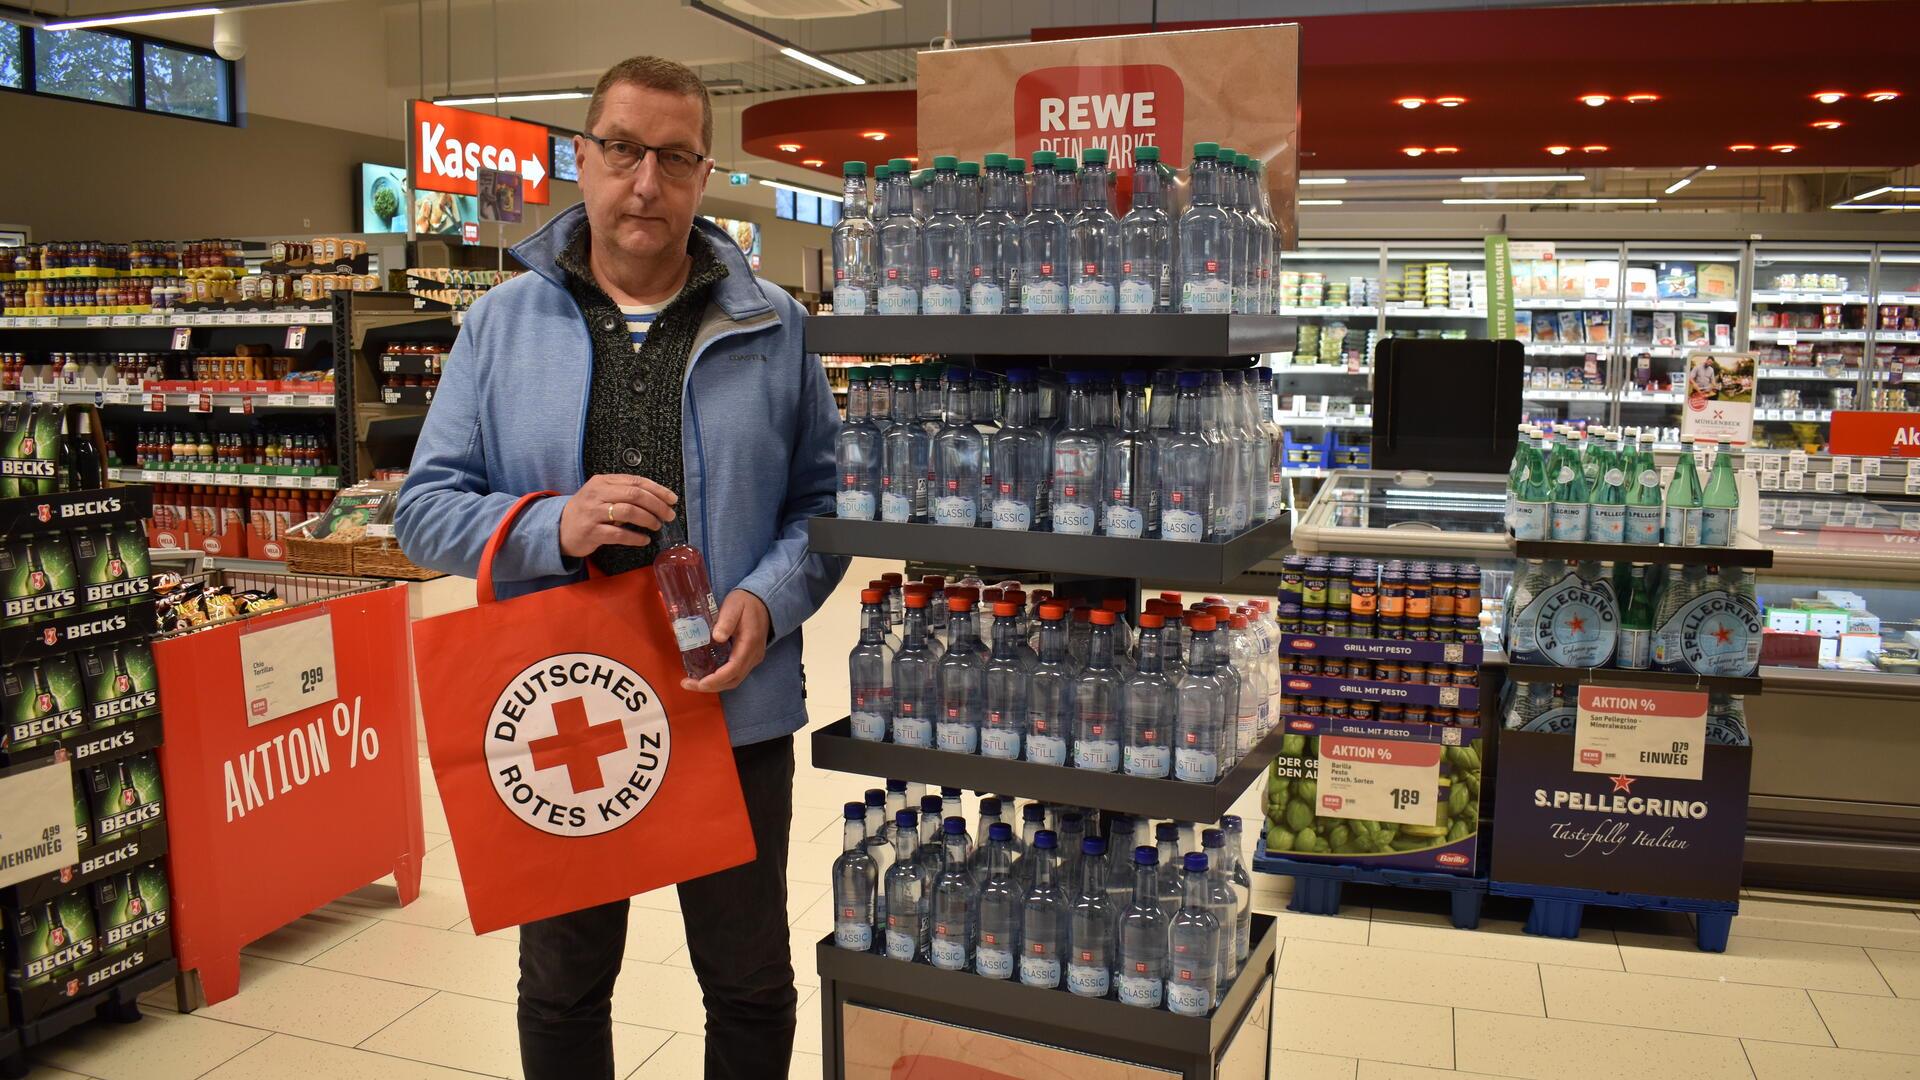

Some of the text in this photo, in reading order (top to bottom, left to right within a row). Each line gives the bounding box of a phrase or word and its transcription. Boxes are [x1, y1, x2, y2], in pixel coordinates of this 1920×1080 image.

[1040, 92, 1157, 132] REWE
[421, 121, 517, 182] Kasse
[1495, 242, 1505, 300] MARGARINE
[1029, 294, 1064, 304] MEDIUM
[1074, 294, 1109, 304] MEDIUM
[1192, 293, 1229, 303] MEDIUM
[1695, 418, 1740, 427] MÜHLENBECK
[2, 460, 55, 476] BECK'S
[61, 497, 122, 518] BECK'S
[937, 508, 972, 518] CLASSIC
[1055, 515, 1089, 526] CLASSIC
[1163, 521, 1198, 532] CLASSIC
[160, 537, 176, 546] HELA
[205, 541, 219, 550] HELA
[265, 547, 281, 556] HELA
[87, 577, 150, 602] BECK'S
[6, 589, 76, 617] BECK'S
[1540, 590, 1614, 651] S.PELLEGRINO
[66, 615, 127, 640] BECK'S
[1684, 600, 1760, 663] S.PELLEGRINO
[1293, 640, 1313, 648] Barilla
[1344, 643, 1366, 652] GRILL
[1385, 647, 1412, 655] PESTO
[253, 661, 265, 669] Chio
[253, 666, 274, 676] Tortillas
[1289, 680, 1309, 689] Barilla
[1340, 685, 1407, 697] GRILL MIT PESTO
[94, 690, 156, 719] BECK'S
[494, 661, 648, 743] DEUTSCHES
[1592, 696, 1656, 711] AKTION %
[13, 709, 83, 741] BECK'S
[1292, 721, 1313, 729] Barilla
[1590, 722, 1637, 730] Mineralwasser
[1604, 715, 1637, 724] Pellegrino
[896, 728, 922, 739] STILL
[1342, 726, 1365, 734] GRILL
[1384, 729, 1410, 737] PESTO
[76, 730, 135, 759] BECK'S
[941, 734, 968, 745] STILL
[983, 740, 1009, 751] STILL
[1029, 746, 1056, 758] STILL
[1082, 752, 1112, 763] STILL
[1332, 745, 1392, 760] AKTION %
[1640, 751, 1689, 766] EINWEG
[224, 695, 380, 823] AKTION %
[1134, 757, 1162, 769] STILL
[1278, 757, 1301, 767] DER
[1178, 759, 1206, 773] STILL
[1278, 768, 1302, 778] DEN
[500, 732, 661, 828] ROTES KREUZ
[1354, 777, 1374, 785] Sorten
[1390, 788, 1420, 810] 1.89
[1534, 789, 1708, 820] S.PELLEGRINO
[101, 802, 161, 834] BECK'S
[1550, 819, 1690, 858] Tastefully Italian
[81, 842, 139, 875] BECK'S
[1440, 854, 1465, 863] Barilla
[107, 910, 166, 945] BECK'S
[27, 938, 94, 978] BECK'S
[87, 951, 144, 987] BECK'S
[1023, 966, 1056, 979] CLASSIC
[1070, 974, 1105, 987] CLASSIC
[1123, 986, 1158, 999] CLASSIC
[1169, 993, 1205, 1007] CLASSIC
